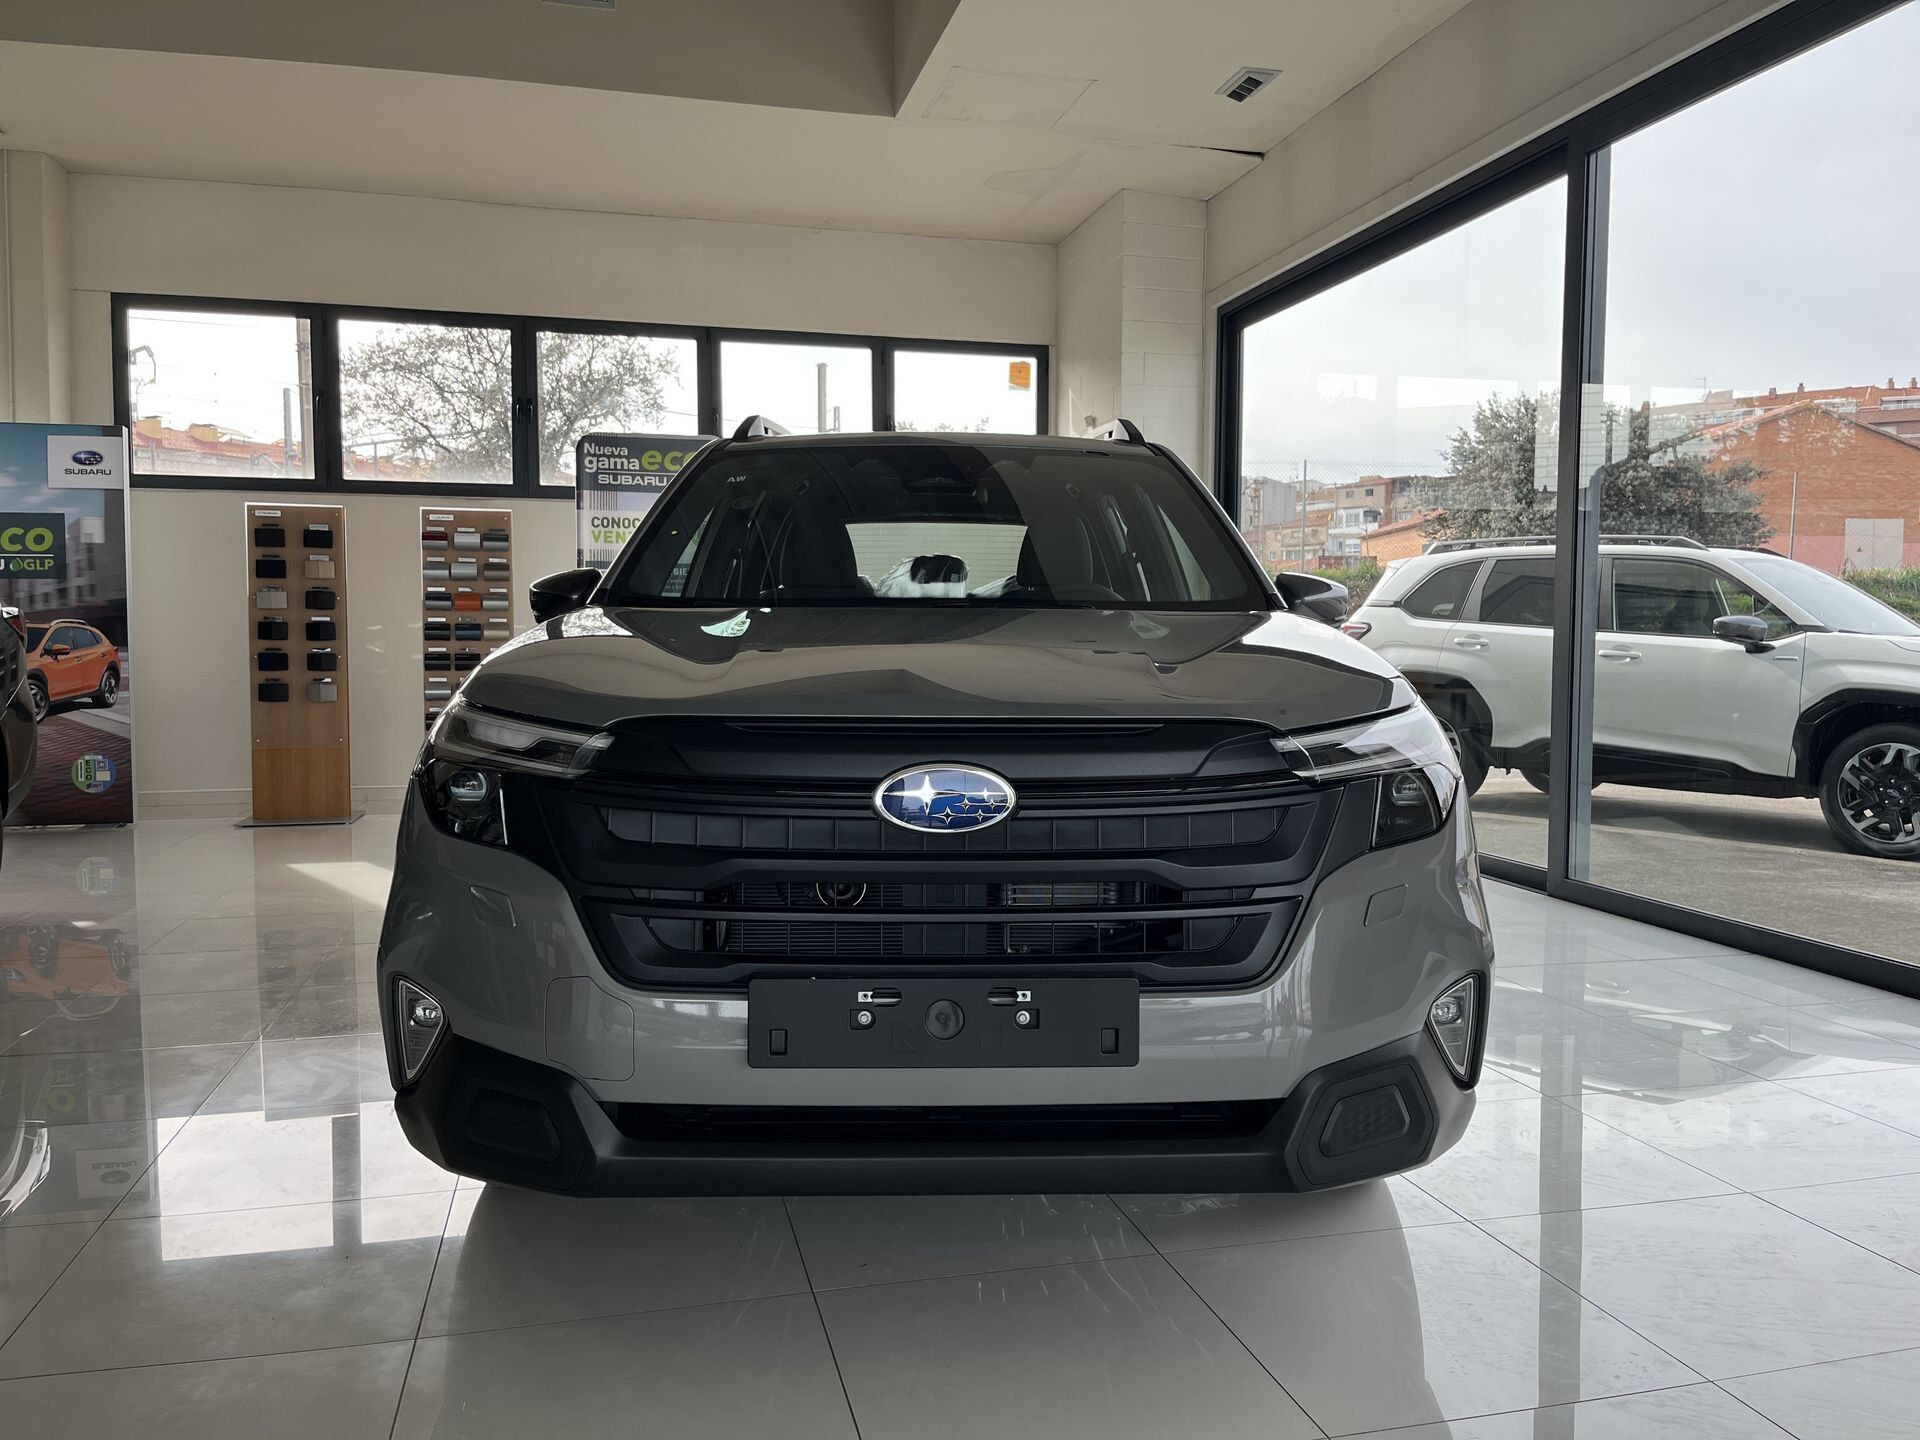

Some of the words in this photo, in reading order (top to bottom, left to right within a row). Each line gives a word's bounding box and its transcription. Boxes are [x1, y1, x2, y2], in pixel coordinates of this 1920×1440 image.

[584, 443, 628, 456] Nueva
[584, 456, 640, 473] gama
[64, 468, 112, 476] SUBARU
[598, 474, 667, 486] SUBARU
[23, 558, 54, 571] GLP
